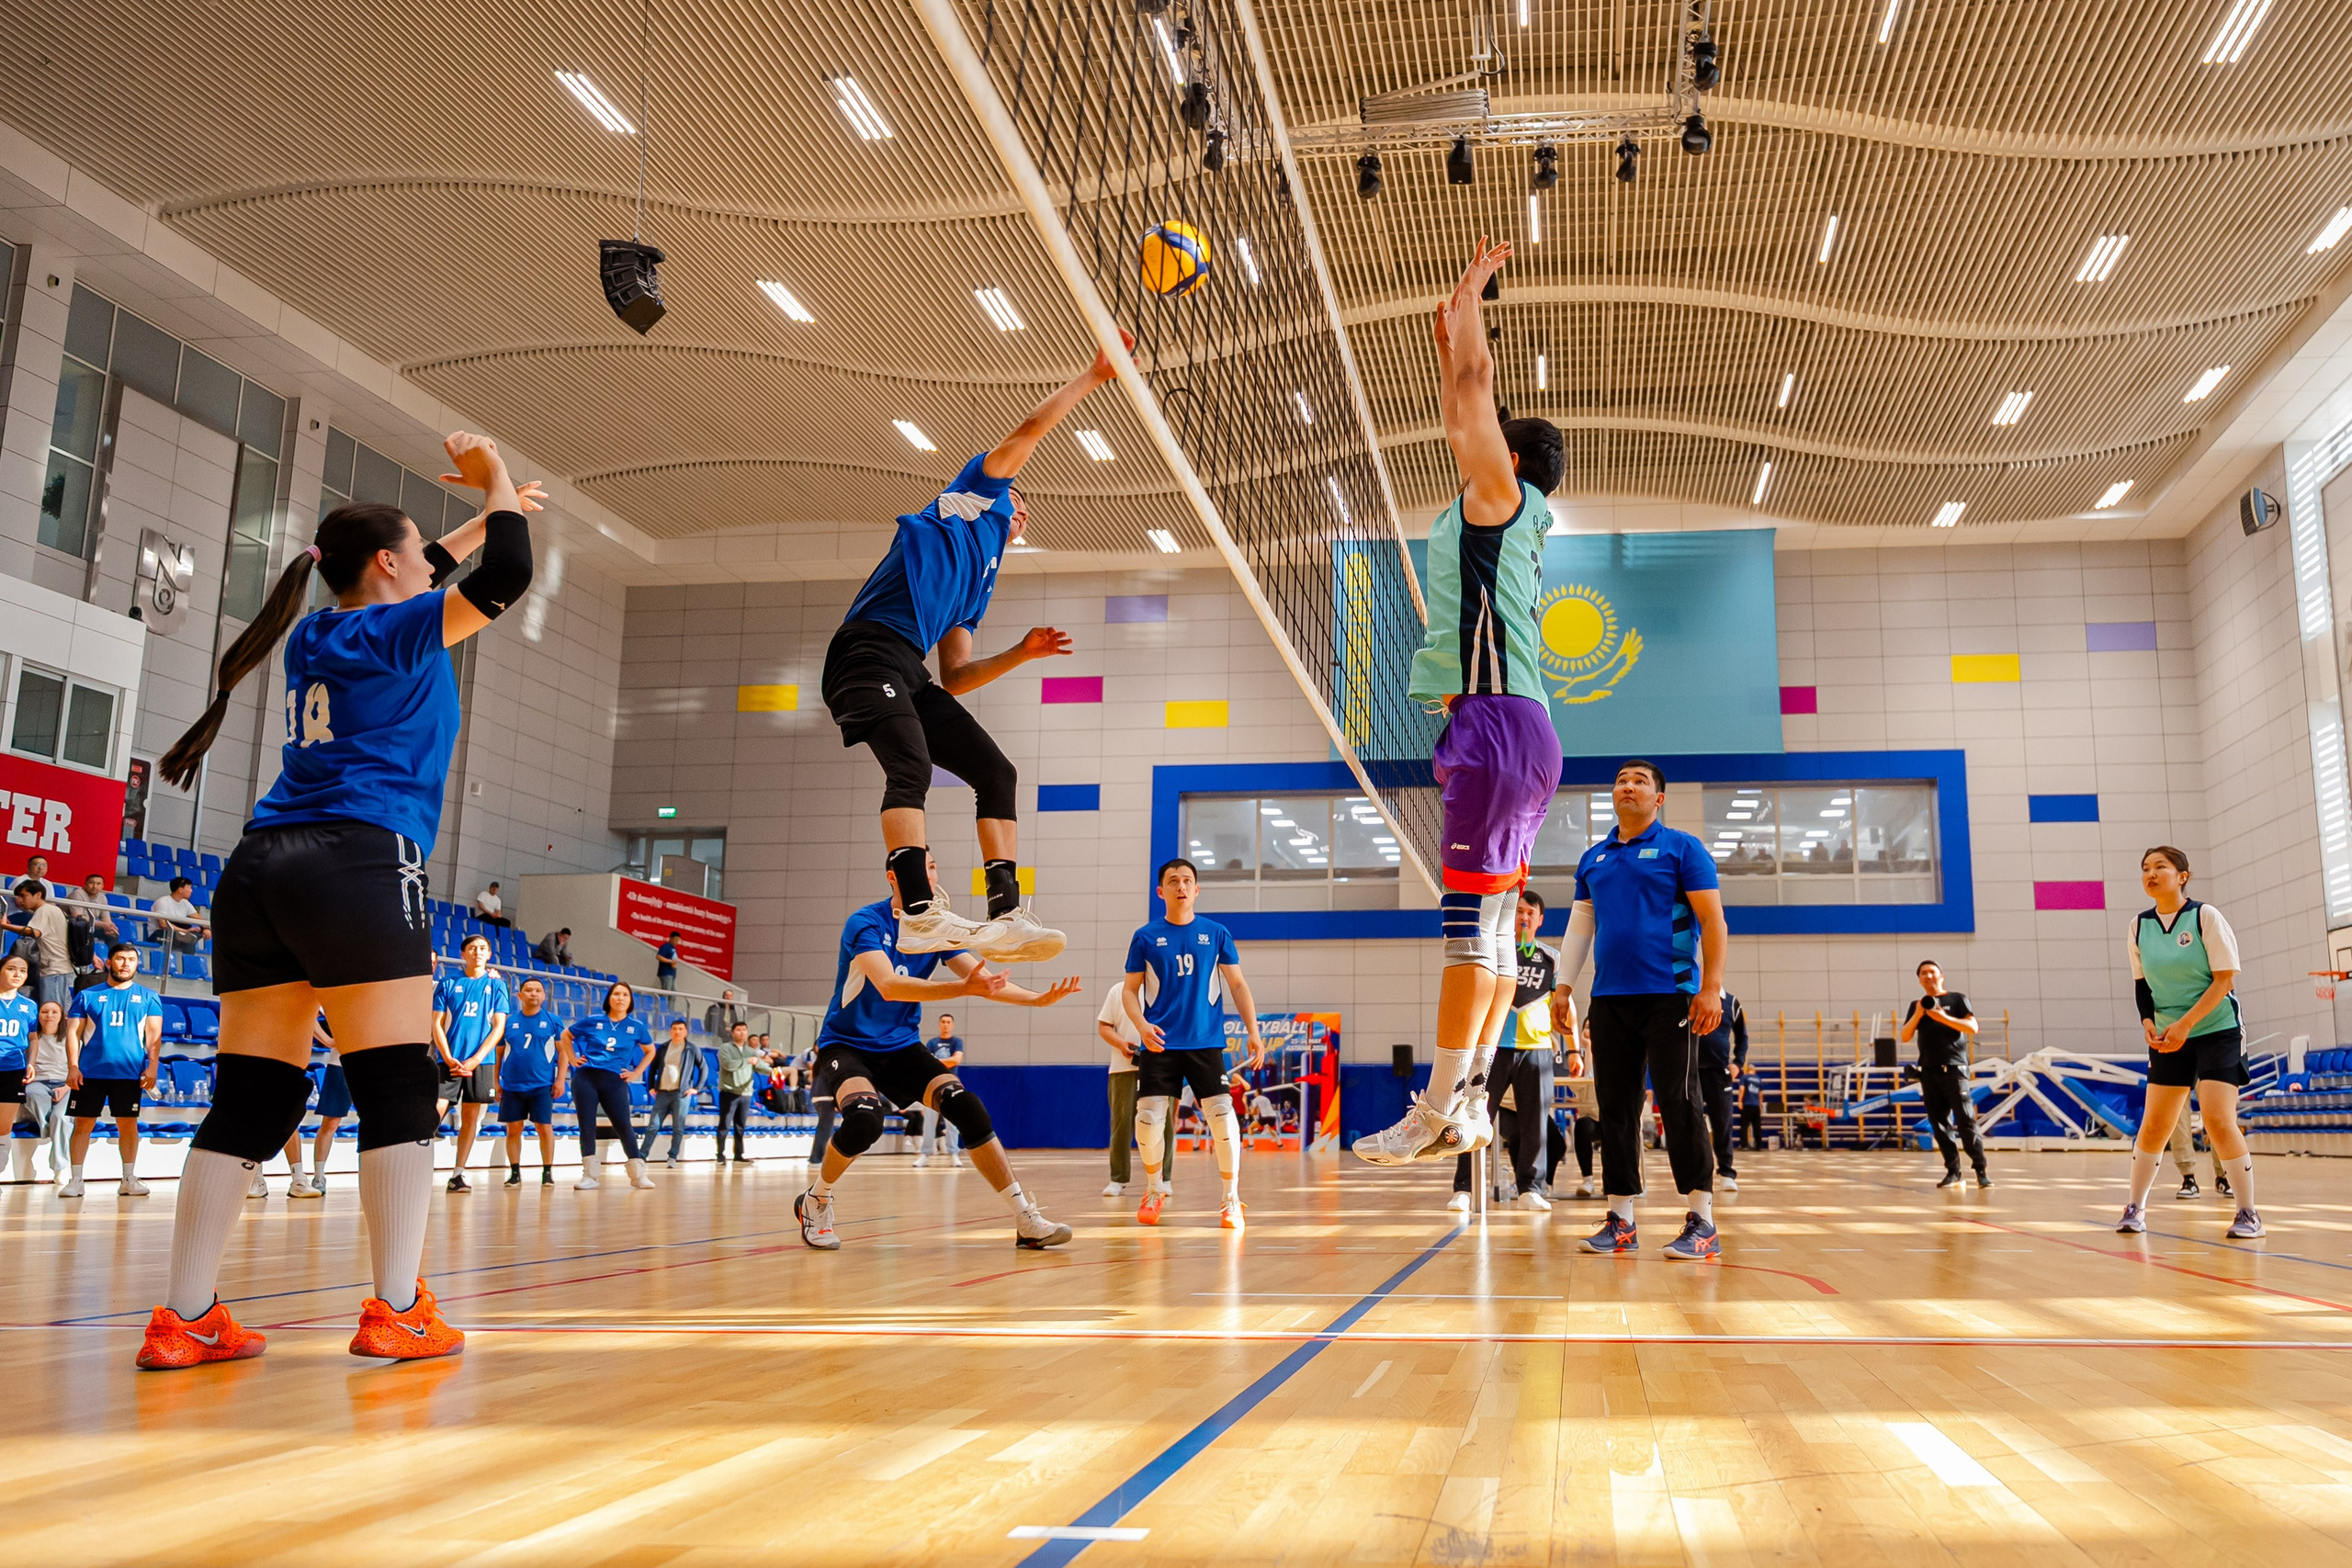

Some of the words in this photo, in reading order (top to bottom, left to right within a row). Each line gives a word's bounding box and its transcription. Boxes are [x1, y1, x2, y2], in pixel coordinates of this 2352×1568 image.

[883, 683, 896, 697] 5
[287, 682, 334, 748] 18
[1176, 953, 1194, 977] 19
[464, 1001, 479, 1017] 12
[109, 1011, 124, 1027] 11
[524, 1033, 532, 1049] 7
[605, 1037, 616, 1052] 2
[831, 1060, 839, 1070] 9
